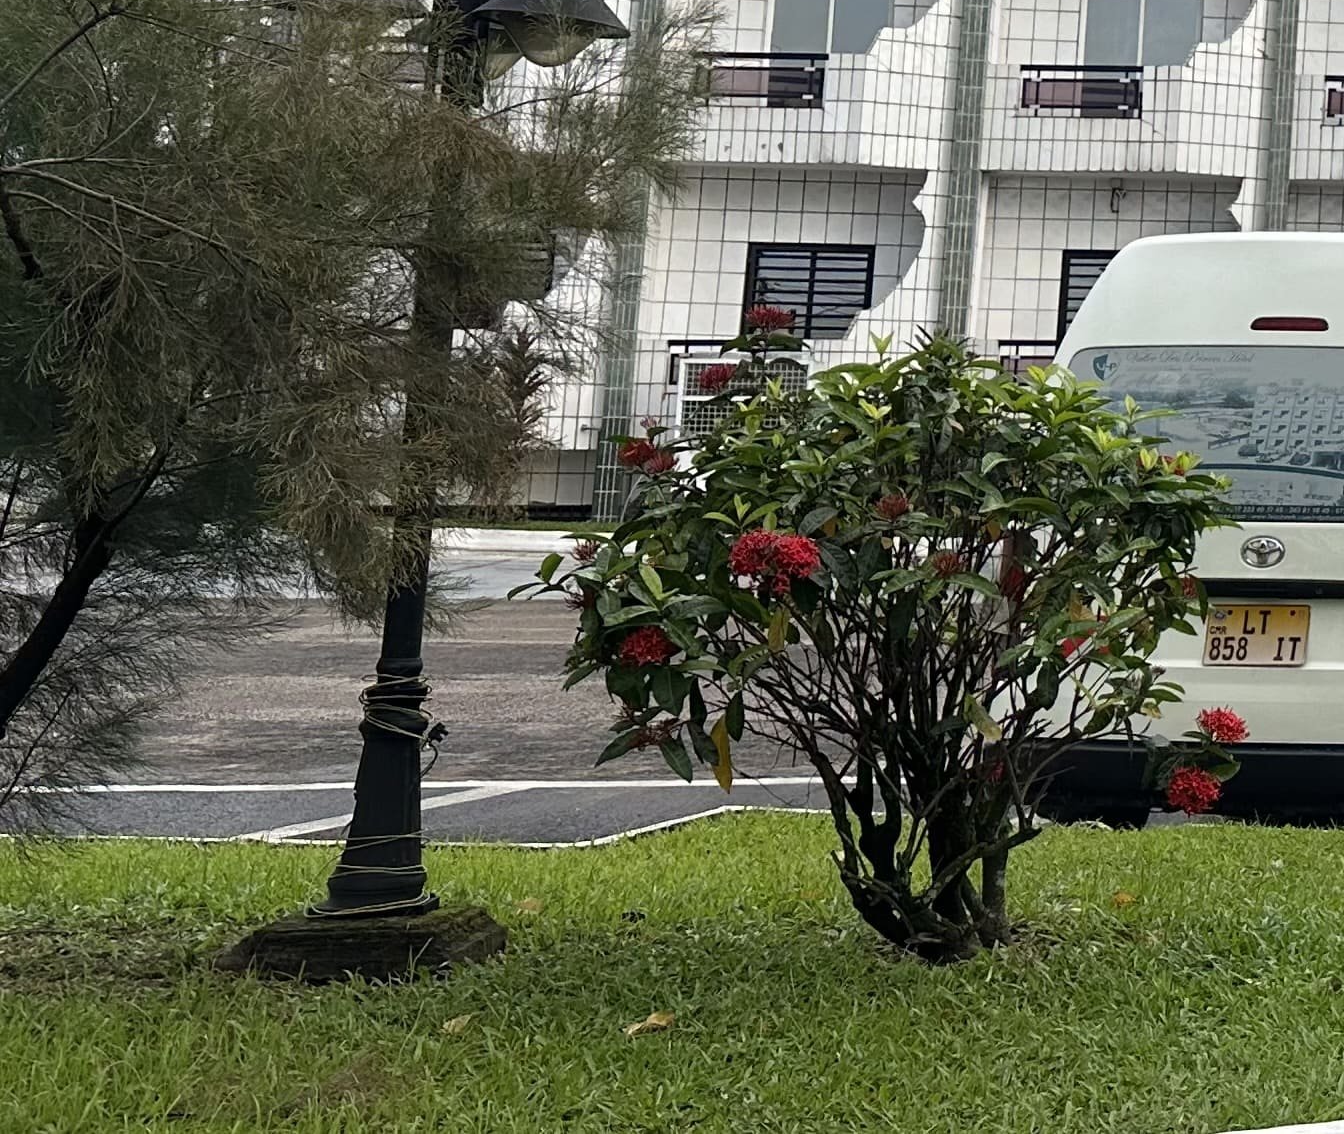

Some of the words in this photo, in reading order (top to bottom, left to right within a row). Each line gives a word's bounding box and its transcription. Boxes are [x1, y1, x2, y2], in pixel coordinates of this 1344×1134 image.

[1209, 626, 1226, 635] CMR
[1243, 610, 1271, 635] LT
[1209, 636, 1248, 661] 858
[1273, 636, 1301, 661] IT
